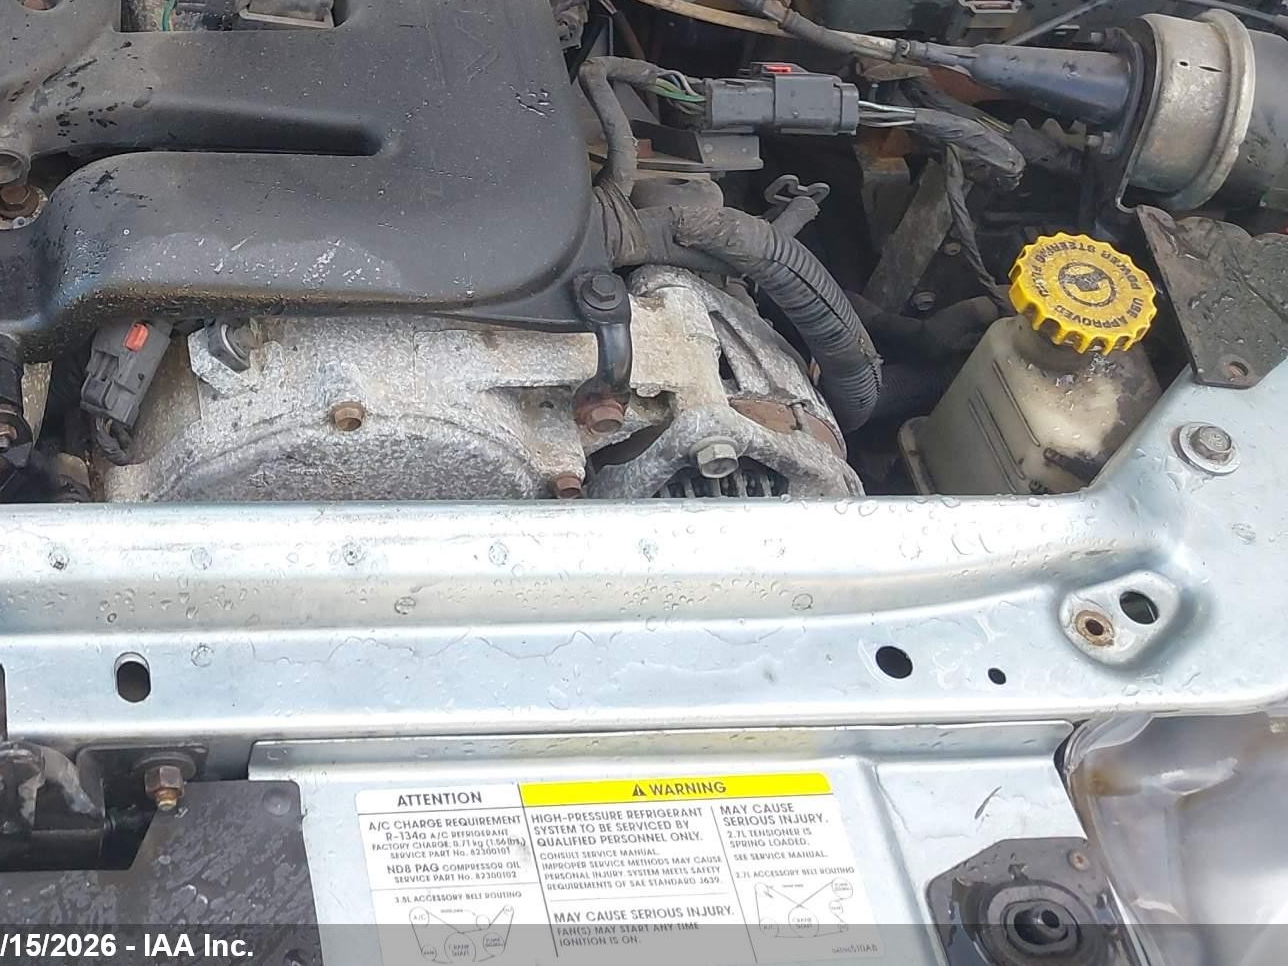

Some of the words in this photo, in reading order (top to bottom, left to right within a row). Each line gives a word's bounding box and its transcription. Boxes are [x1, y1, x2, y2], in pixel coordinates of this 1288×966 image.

[1101, 250, 1142, 290] POWER
[1054, 304, 1128, 328] APPROVED
[649, 781, 727, 796] WARNING
[397, 791, 483, 807] ATTENTION
[531, 810, 623, 823] HIGH-PRESSURE
[626, 807, 703, 820] REFRIGERANT
[720, 805, 747, 815] MAY
[752, 803, 794, 814] CAUSE
[368, 821, 390, 831] A/C
[394, 819, 443, 830] CHARGE
[445, 815, 521, 827] REQUIREMENT
[534, 824, 577, 835] SYSTEM
[579, 823, 595, 833] TO
[599, 822, 613, 832] BE
[615, 820, 672, 832] SERVICED
[676, 819, 690, 829] BY
[723, 815, 776, 827] SERIOUS
[779, 813, 829, 825] INJURY.
[385, 831, 426, 842] R-134a
[430, 831, 448, 839] A/C
[451, 829, 509, 838] REFRIGERANT
[536, 835, 597, 847] QUALIFIED
[600, 833, 667, 844] PERSONNEL
[670, 831, 703, 841] ONLY.
[727, 830, 747, 838] 2.7L
[749, 828, 800, 838] TENSIONER
[372, 842, 409, 851] FACTORY
[730, 839, 766, 848] SPRING
[769, 838, 810, 846] LOADED.
[390, 851, 426, 859] SERVICE
[429, 850, 450, 858] PART
[540, 851, 580, 860] CONSULT
[582, 850, 617, 858] SERVICE
[734, 853, 748, 861] SEE
[751, 852, 786, 860] SERVICE
[415, 863, 439, 873] PAG
[442, 862, 503, 872] COMPRESSOR
[506, 861, 520, 869] OIL
[541, 861, 587, 871] IMPROPER
[589, 859, 626, 868] SERVICE
[627, 858, 669, 867] METHODS
[672, 856, 691, 865] MAY
[693, 855, 722, 864] CAUSE
[394, 875, 430, 883] SERVICE
[433, 874, 455, 882] PART
[457, 873, 473, 881] No.
[544, 871, 590, 881] PERSONAL
[627, 868, 660, 877] SYSTEM
[662, 867, 688, 875] MEETS
[691, 866, 721, 874] SAFETY
[753, 869, 800, 878] ACCESSORY
[819, 866, 855, 874] ROUTING
[546, 881, 613, 891] REQUIREMENTS
[615, 880, 627, 888] OF
[630, 879, 646, 887] SAE
[649, 877, 696, 886] STANDARD
[413, 894, 463, 903] ACCESSORY
[465, 892, 483, 900] BELT
[485, 891, 522, 899] ROUTING
[553, 911, 581, 923] MAY
[585, 909, 628, 922] CAUSE
[630, 907, 684, 920] SERIOUS
[687, 905, 735, 918] INJURY.
[557, 926, 592, 936] FAN(S)
[595, 925, 616, 934] MAY
[619, 924, 650, 933] START
[653, 923, 673, 932] ANY
[676, 921, 700, 930] TIME
[559, 936, 607, 947] IGNITION
[610, 936, 619, 944] IS
[621, 935, 642, 945] ON.
